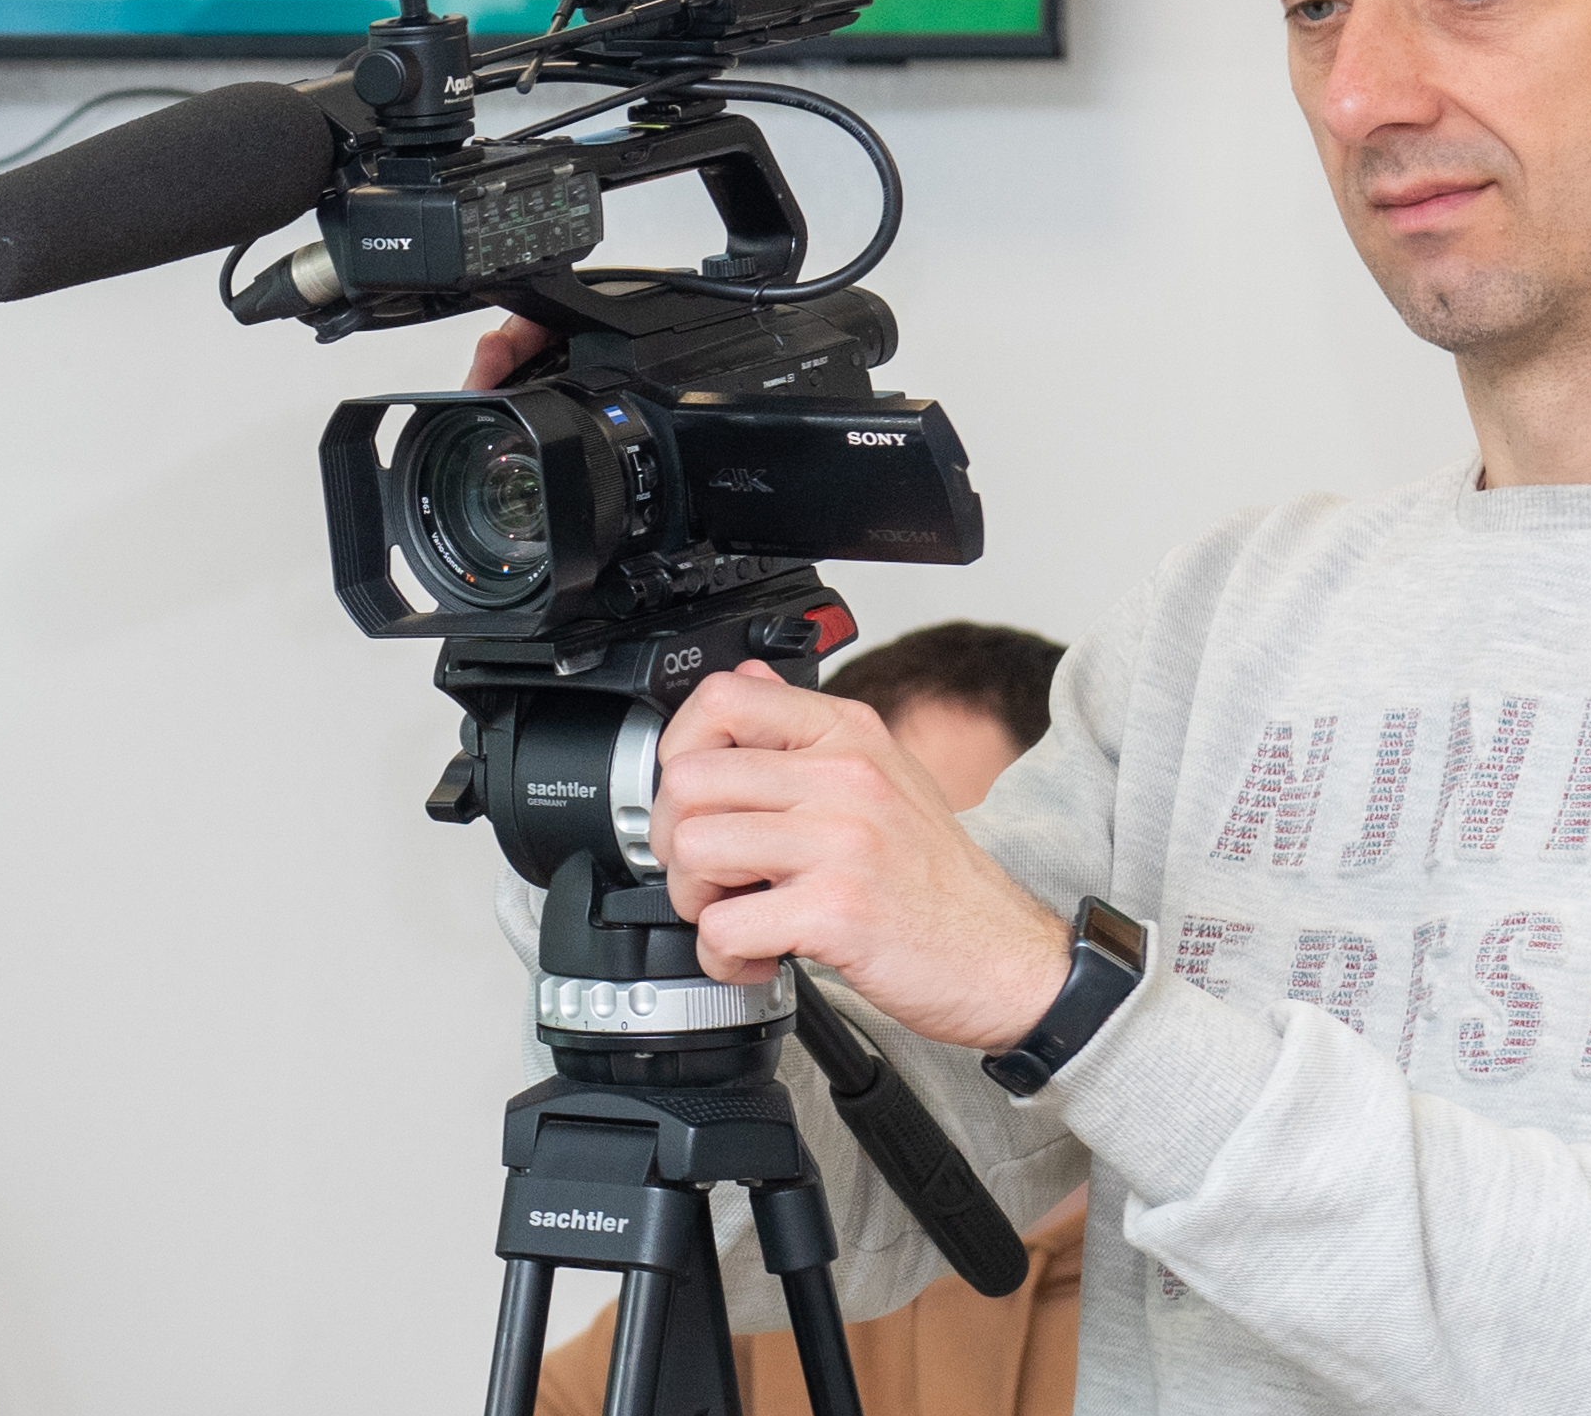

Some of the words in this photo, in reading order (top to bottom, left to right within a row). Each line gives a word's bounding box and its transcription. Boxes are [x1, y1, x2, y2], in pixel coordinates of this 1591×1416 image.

[361, 237, 413, 251] SONY
[847, 431, 907, 446] SONY
[431, 531, 466, 576] Vario-Sonnar
[664, 646, 703, 675] ace
[527, 780, 597, 798] sachtler
[527, 797, 568, 807] GERMANY
[528, 1208, 629, 1235] sachtler
